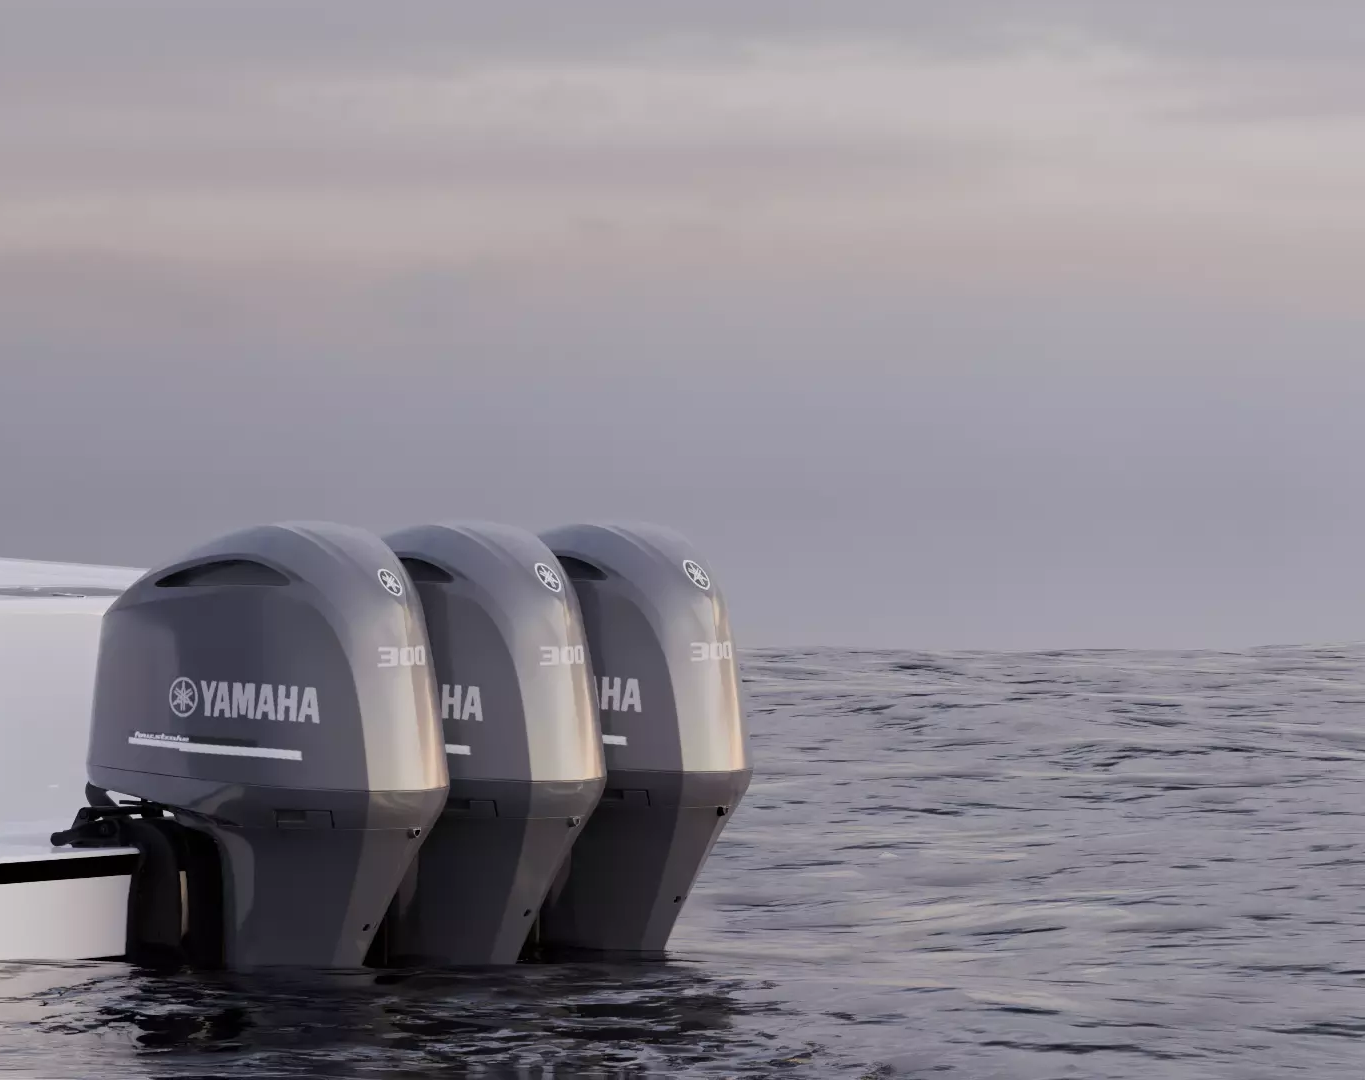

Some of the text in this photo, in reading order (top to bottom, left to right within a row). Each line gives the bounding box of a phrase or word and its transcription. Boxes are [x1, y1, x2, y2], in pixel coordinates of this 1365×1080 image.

[377, 644, 426, 668] 300
[539, 643, 585, 666] 300
[690, 640, 733, 663] 300
[200, 680, 321, 724] YAMAHA
